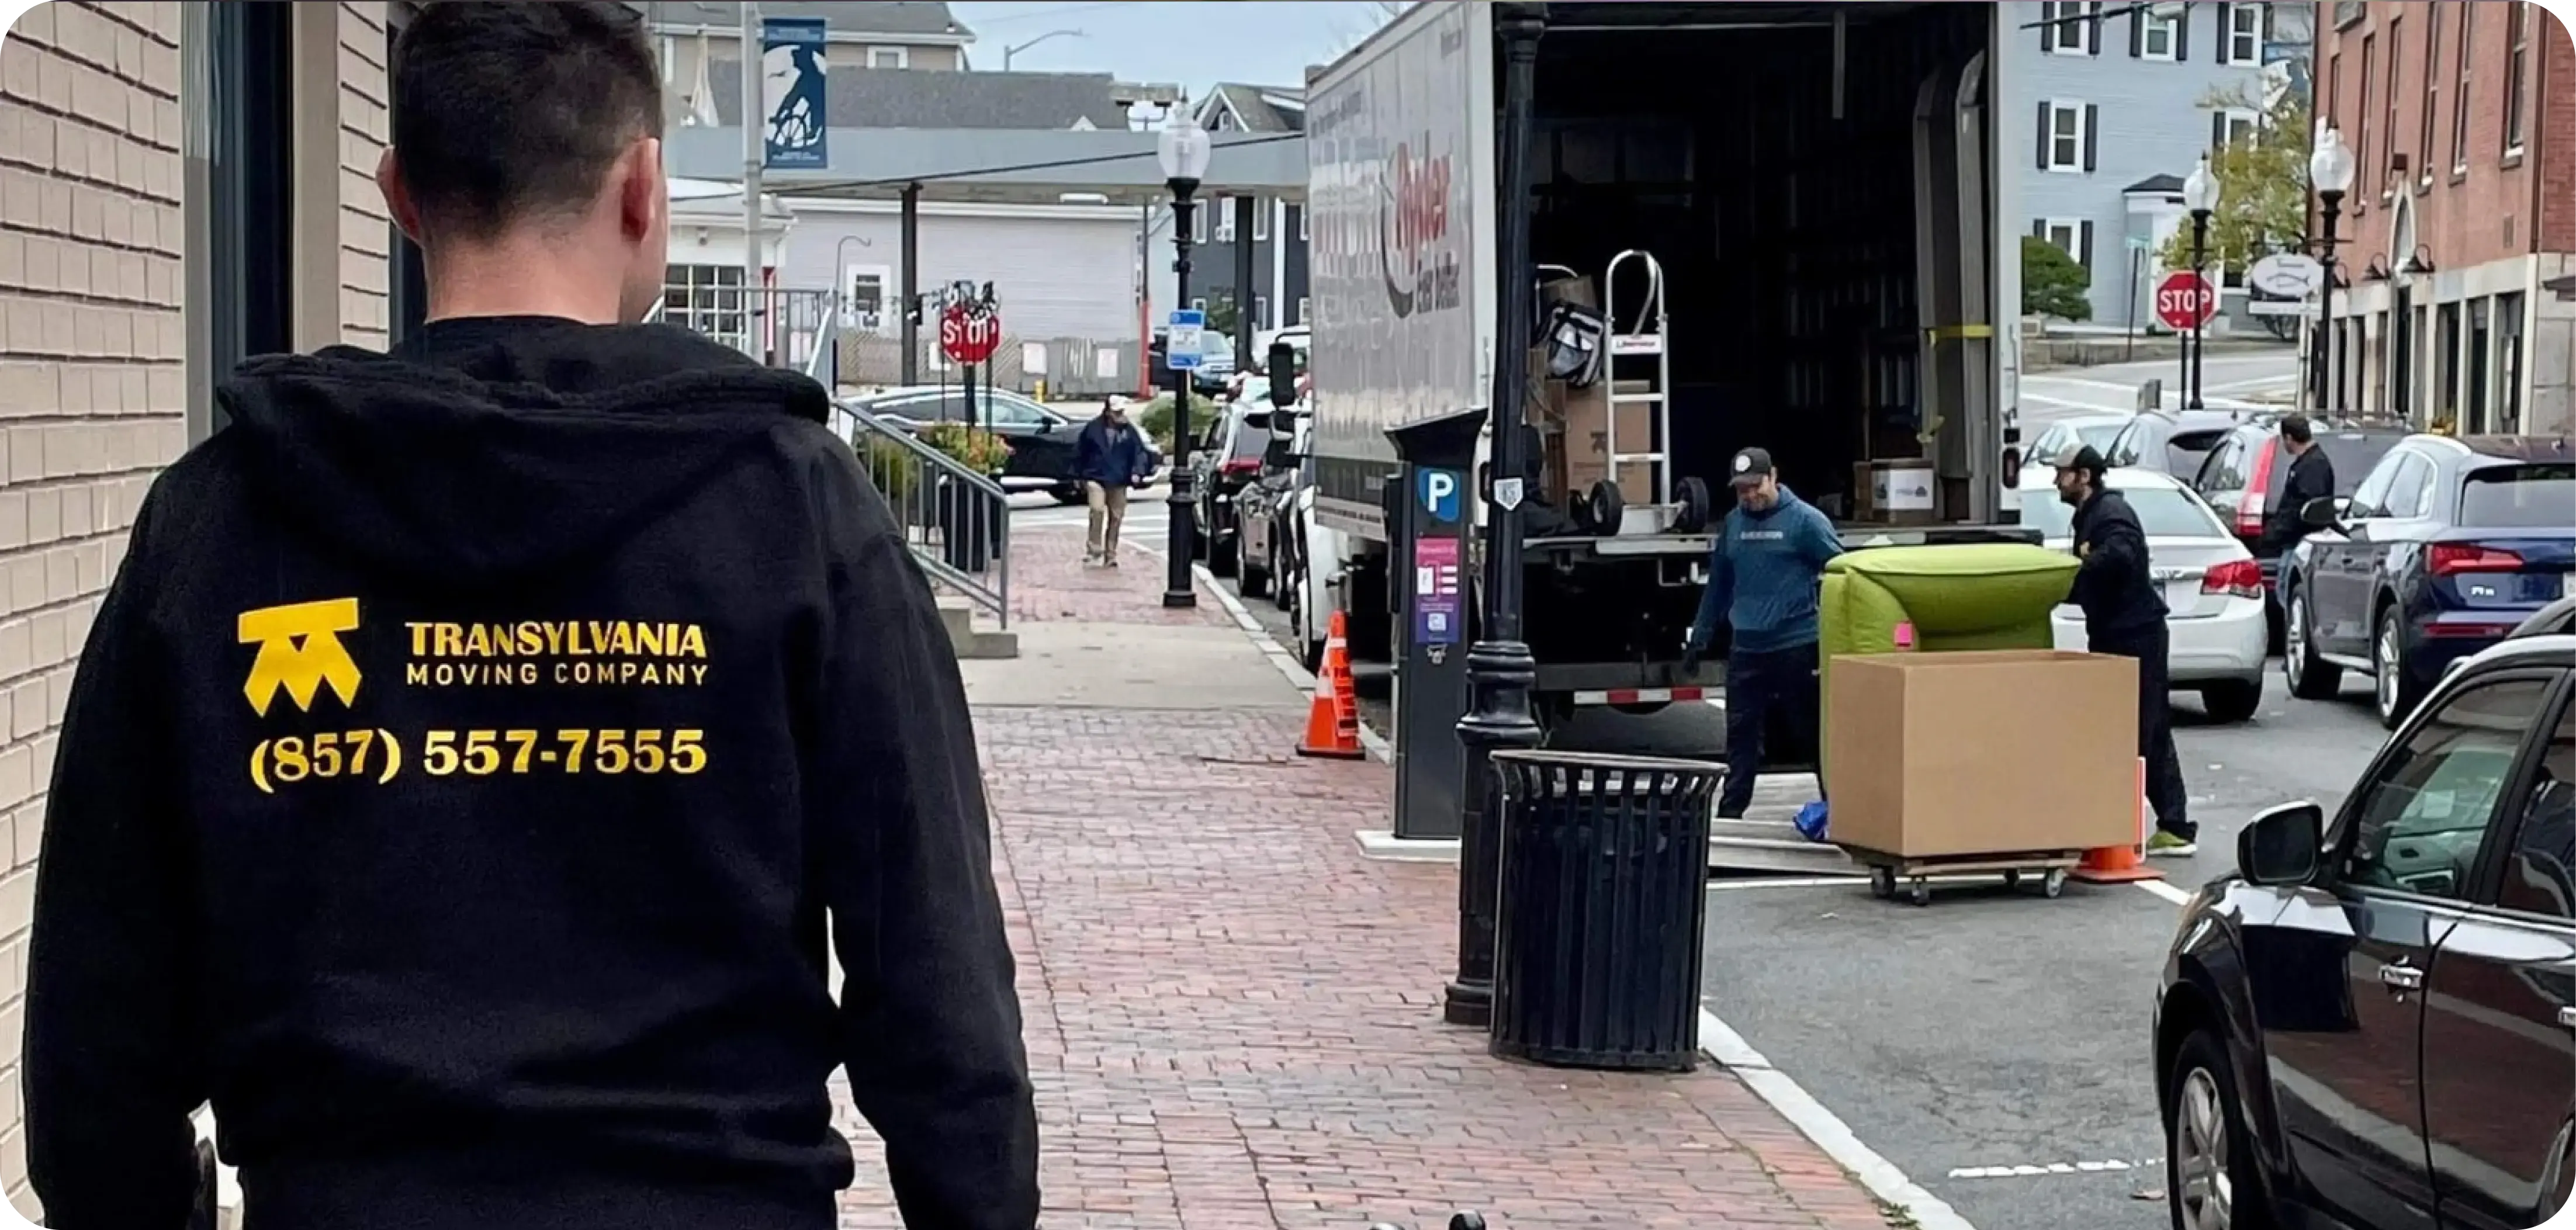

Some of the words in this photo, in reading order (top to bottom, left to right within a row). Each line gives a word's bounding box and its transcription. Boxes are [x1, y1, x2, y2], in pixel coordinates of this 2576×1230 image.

[2160, 289, 2211, 313] STOP
[1428, 472, 1454, 512] P
[404, 621, 707, 658] TRANSYLVANIA
[406, 663, 538, 685] MOVING
[554, 661, 708, 687] COMPANY
[250, 727, 402, 794] (857)
[423, 729, 707, 775] 557-7555
